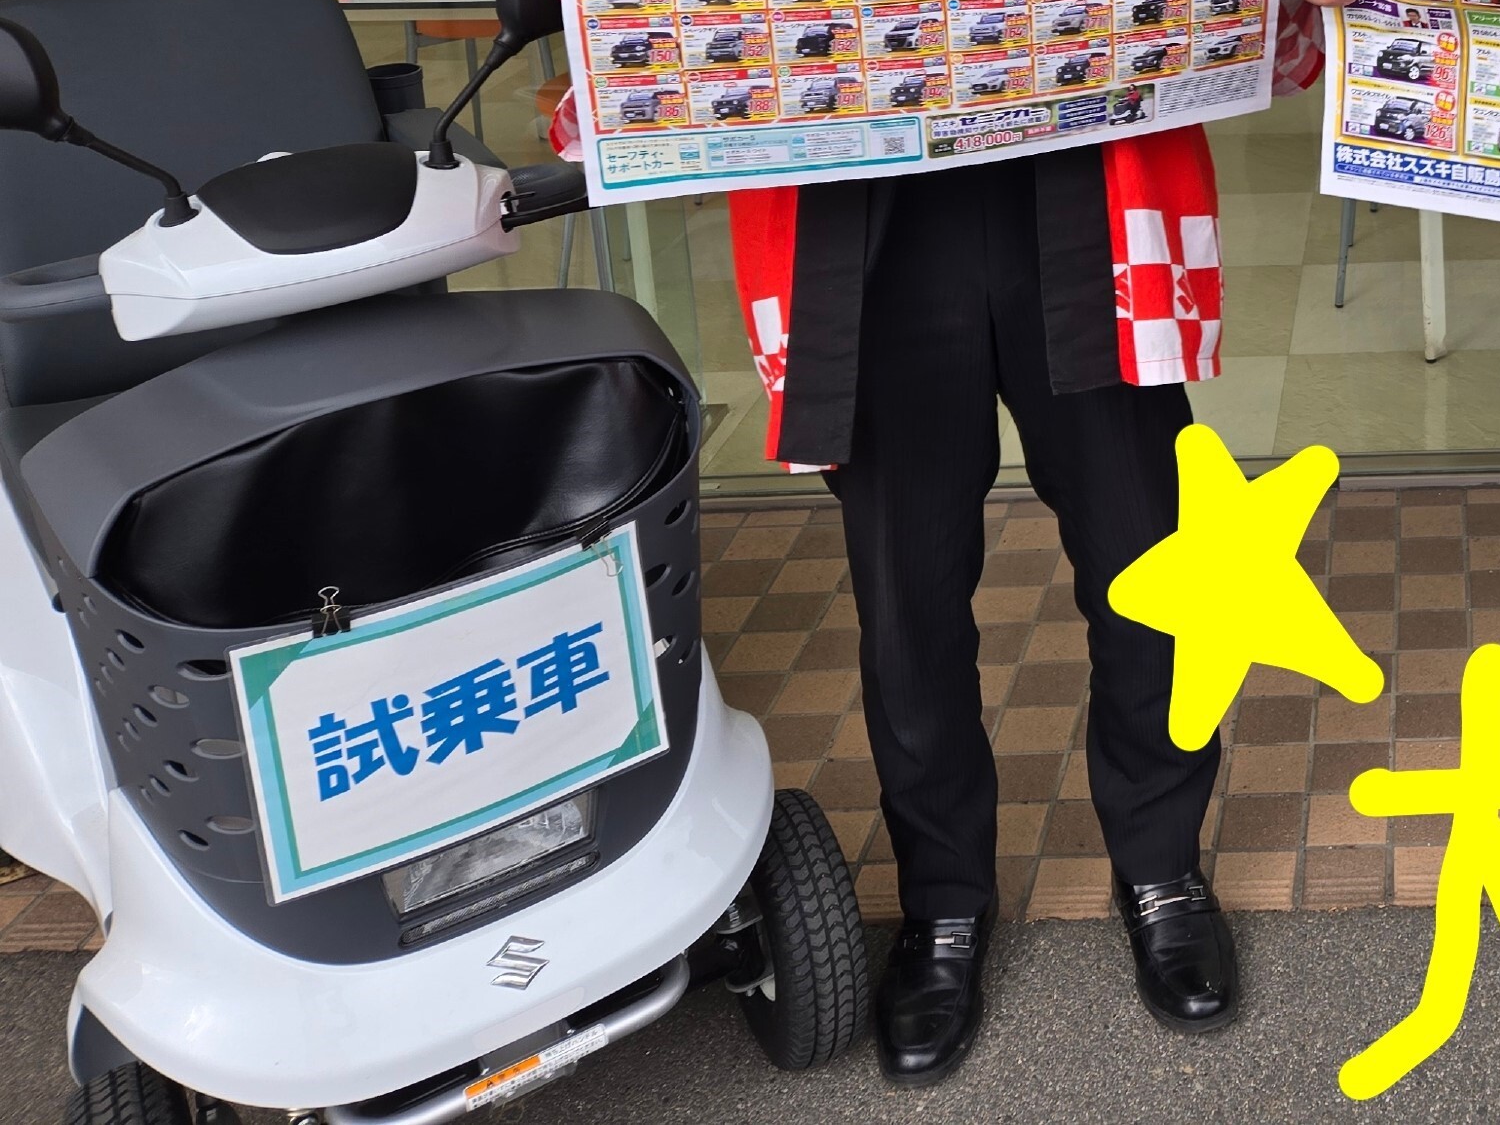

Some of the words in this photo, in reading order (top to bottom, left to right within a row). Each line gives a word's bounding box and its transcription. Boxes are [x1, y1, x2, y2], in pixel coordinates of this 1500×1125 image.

[933, 121, 955, 129] スズキ
[954, 131, 1021, 151] 418,000円
[607, 160, 674, 174] サポートカー
[308, 621, 610, 803] 試乗車
